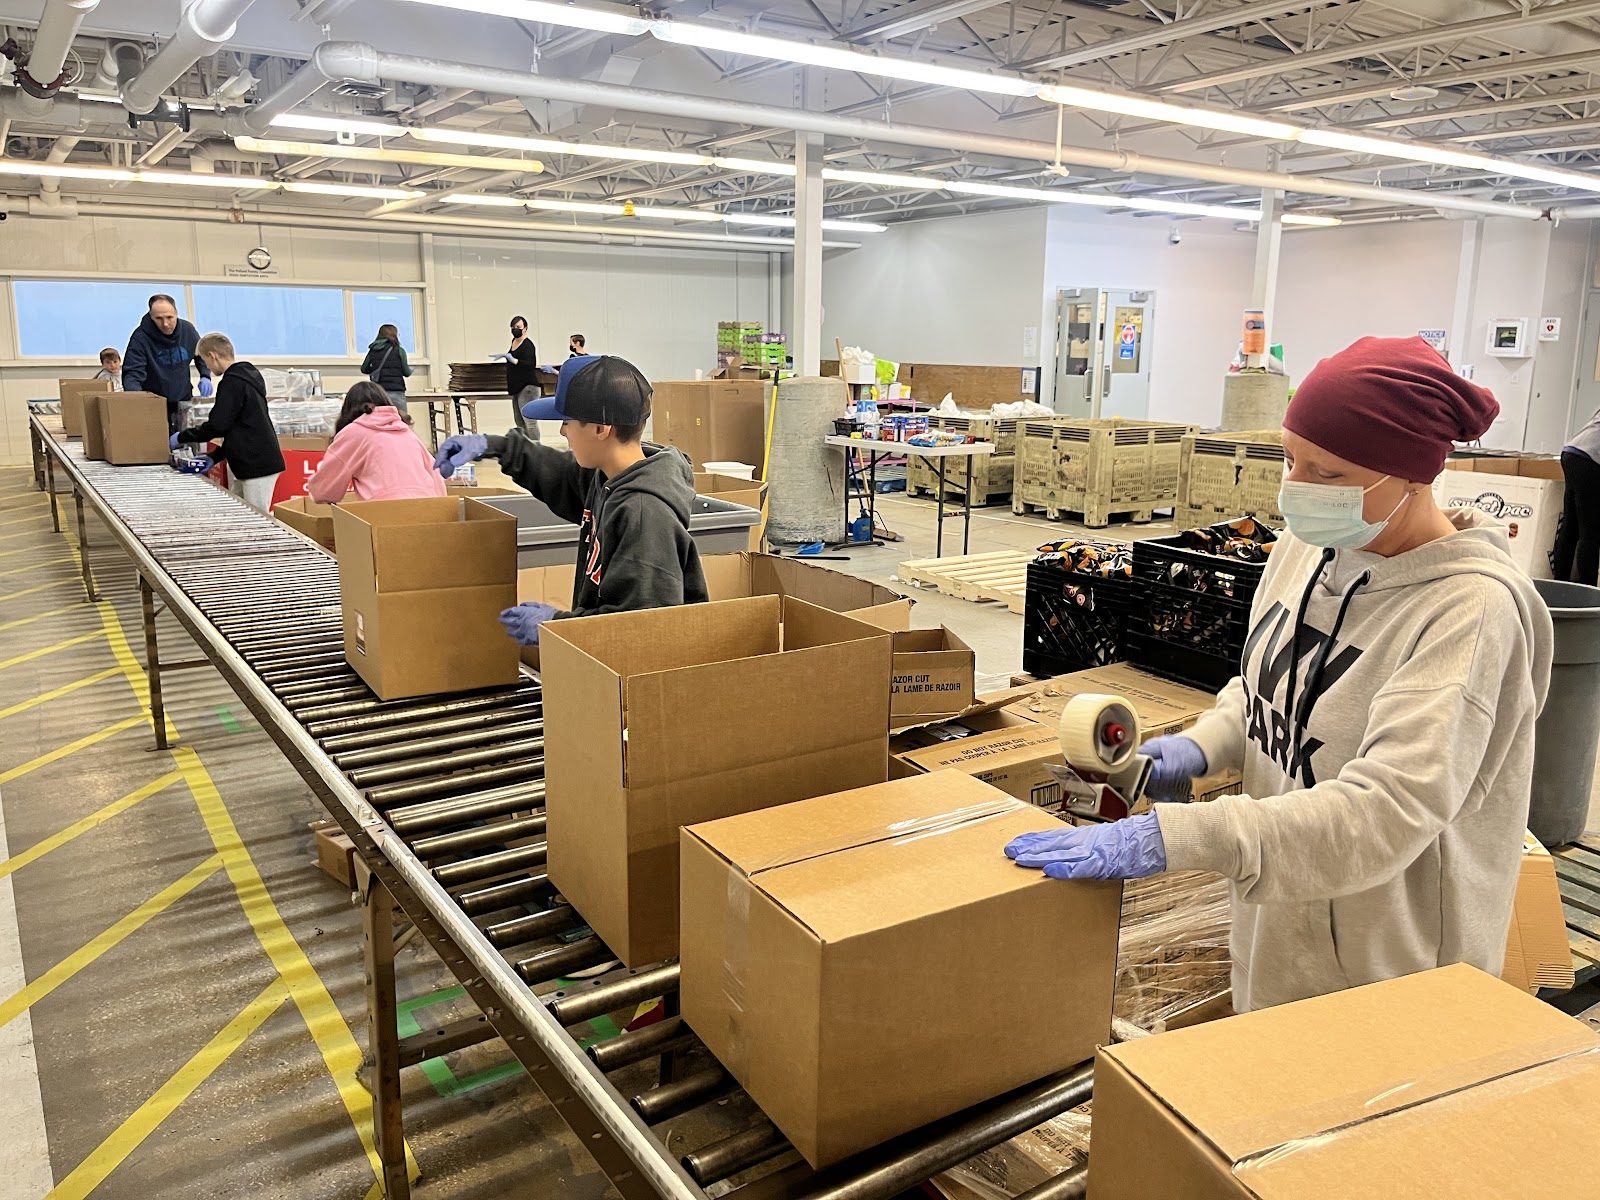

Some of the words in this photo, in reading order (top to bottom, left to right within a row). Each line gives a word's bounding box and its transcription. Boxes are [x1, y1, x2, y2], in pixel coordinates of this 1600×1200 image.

[892, 675, 913, 684] AZOR
[915, 674, 930, 683] CUT
[904, 684, 923, 693] LAME
[924, 684, 934, 692] DE
[936, 682, 961, 692] RAZOIR
[1242, 675, 1325, 789] ARK
